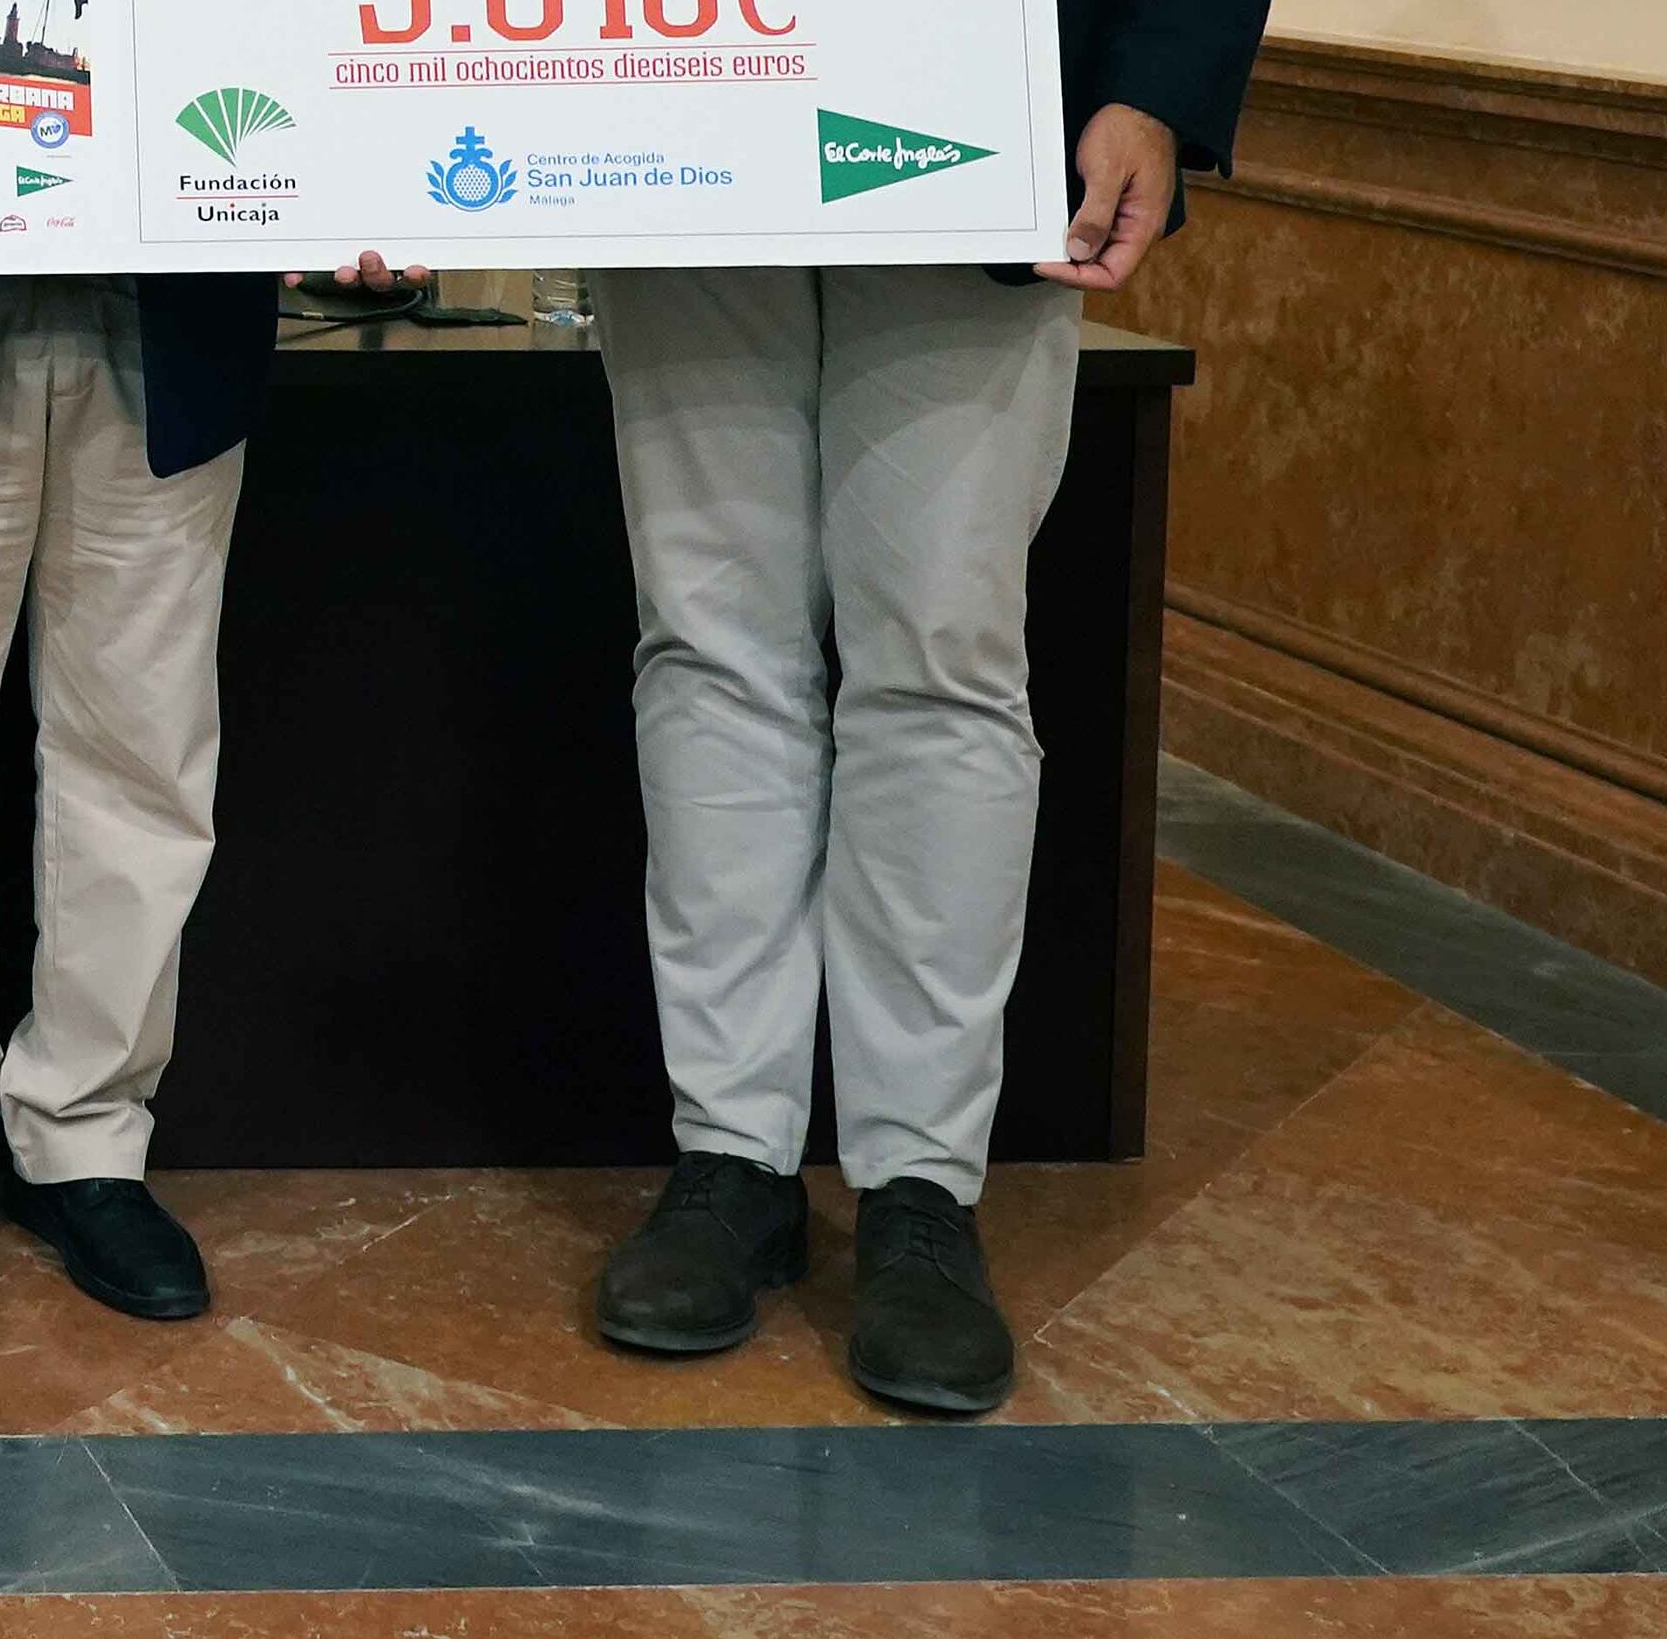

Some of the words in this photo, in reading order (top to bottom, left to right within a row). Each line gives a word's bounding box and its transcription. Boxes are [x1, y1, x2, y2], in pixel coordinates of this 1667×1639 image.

[336, 60, 399, 84] cinco
[409, 57, 446, 82] mil
[456, 55, 604, 81] ochocientos
[614, 52, 722, 80] dieciseis
[733, 53, 805, 77] euros
[527, 153, 577, 166] Centro
[581, 153, 599, 165] de
[603, 152, 665, 167] Acogida
[824, 142, 845, 163] El
[845, 143, 892, 163] Corte
[179, 174, 297, 191] Fundación
[527, 169, 572, 188] San
[579, 169, 636, 187] Juan
[644, 169, 673, 185] de
[680, 166, 733, 186] Dios
[197, 203, 279, 226] Unicaja
